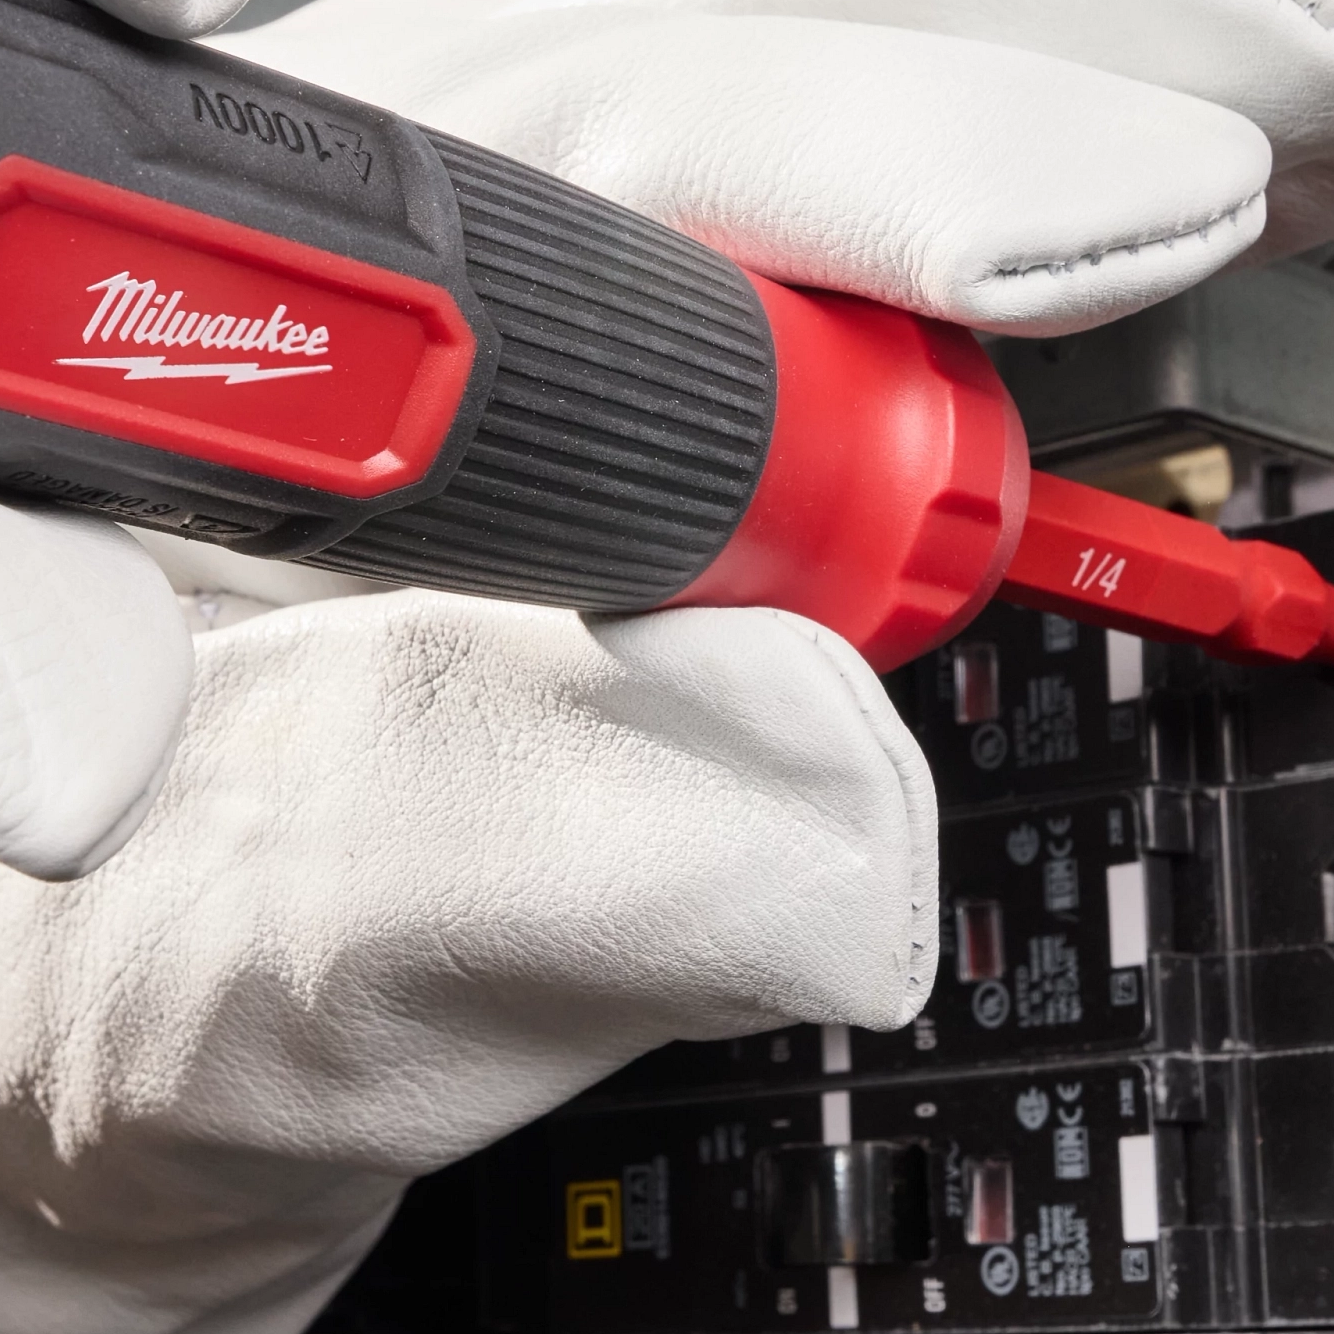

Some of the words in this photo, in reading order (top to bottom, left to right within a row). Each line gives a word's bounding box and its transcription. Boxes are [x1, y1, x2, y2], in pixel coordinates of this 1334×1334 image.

[189, 83, 333, 163] 1000V
[82, 270, 331, 357] Milwaukee
[1070, 546, 1127, 599] 1/4
[923, 1278, 947, 1314] OFF
